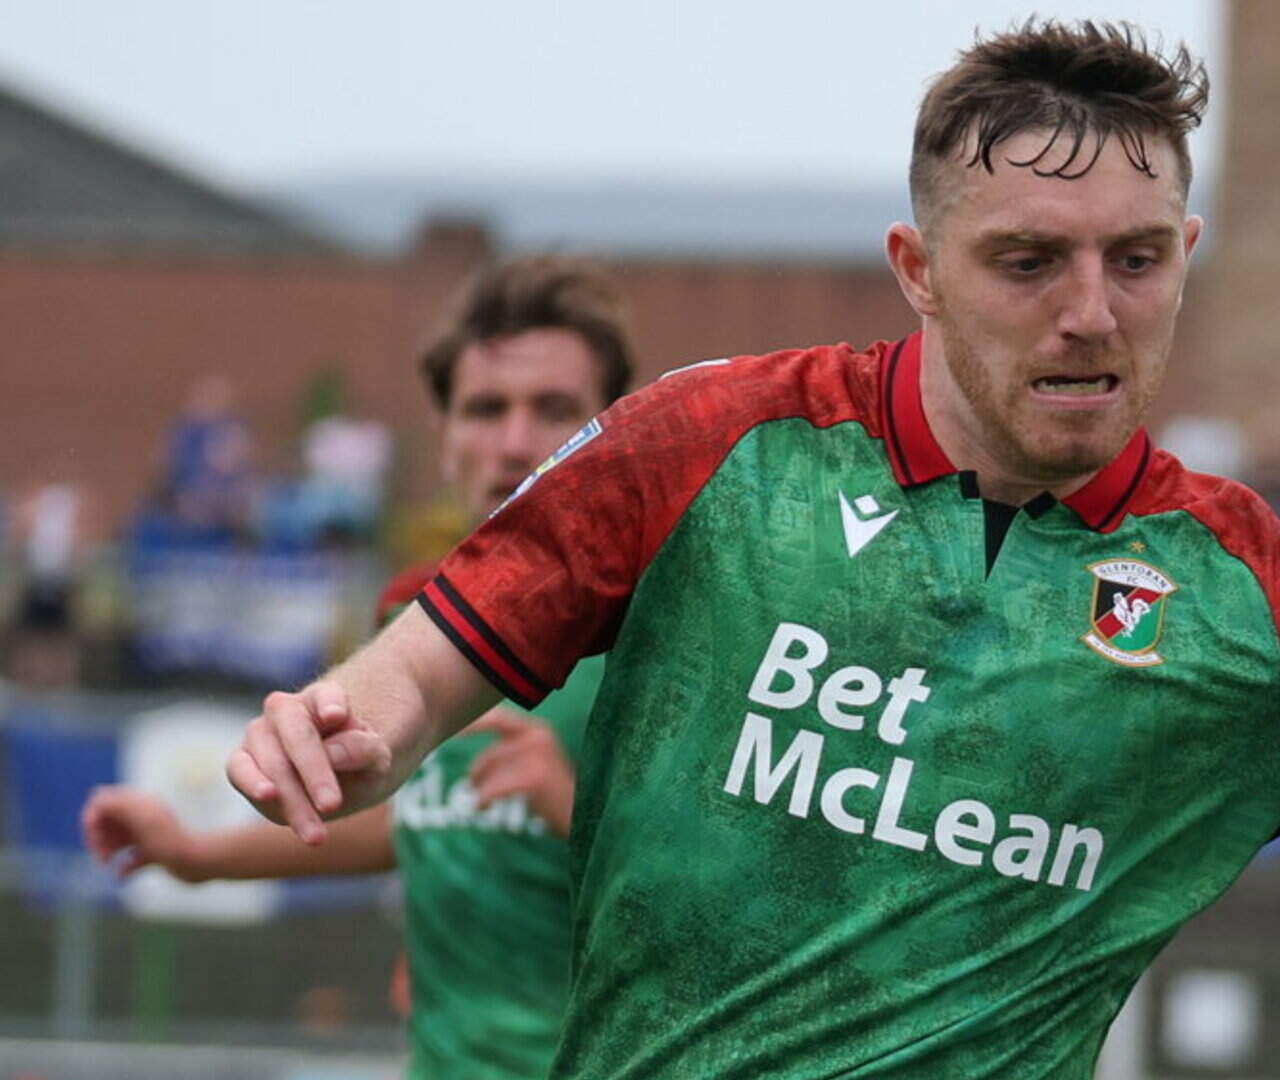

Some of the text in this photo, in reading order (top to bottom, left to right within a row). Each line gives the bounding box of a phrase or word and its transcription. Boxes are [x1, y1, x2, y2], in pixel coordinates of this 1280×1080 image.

[1098, 563, 1168, 589] GLENTORAN
[1126, 575, 1139, 585] FC
[748, 622, 931, 745] Bet
[723, 711, 1105, 892] McLean
